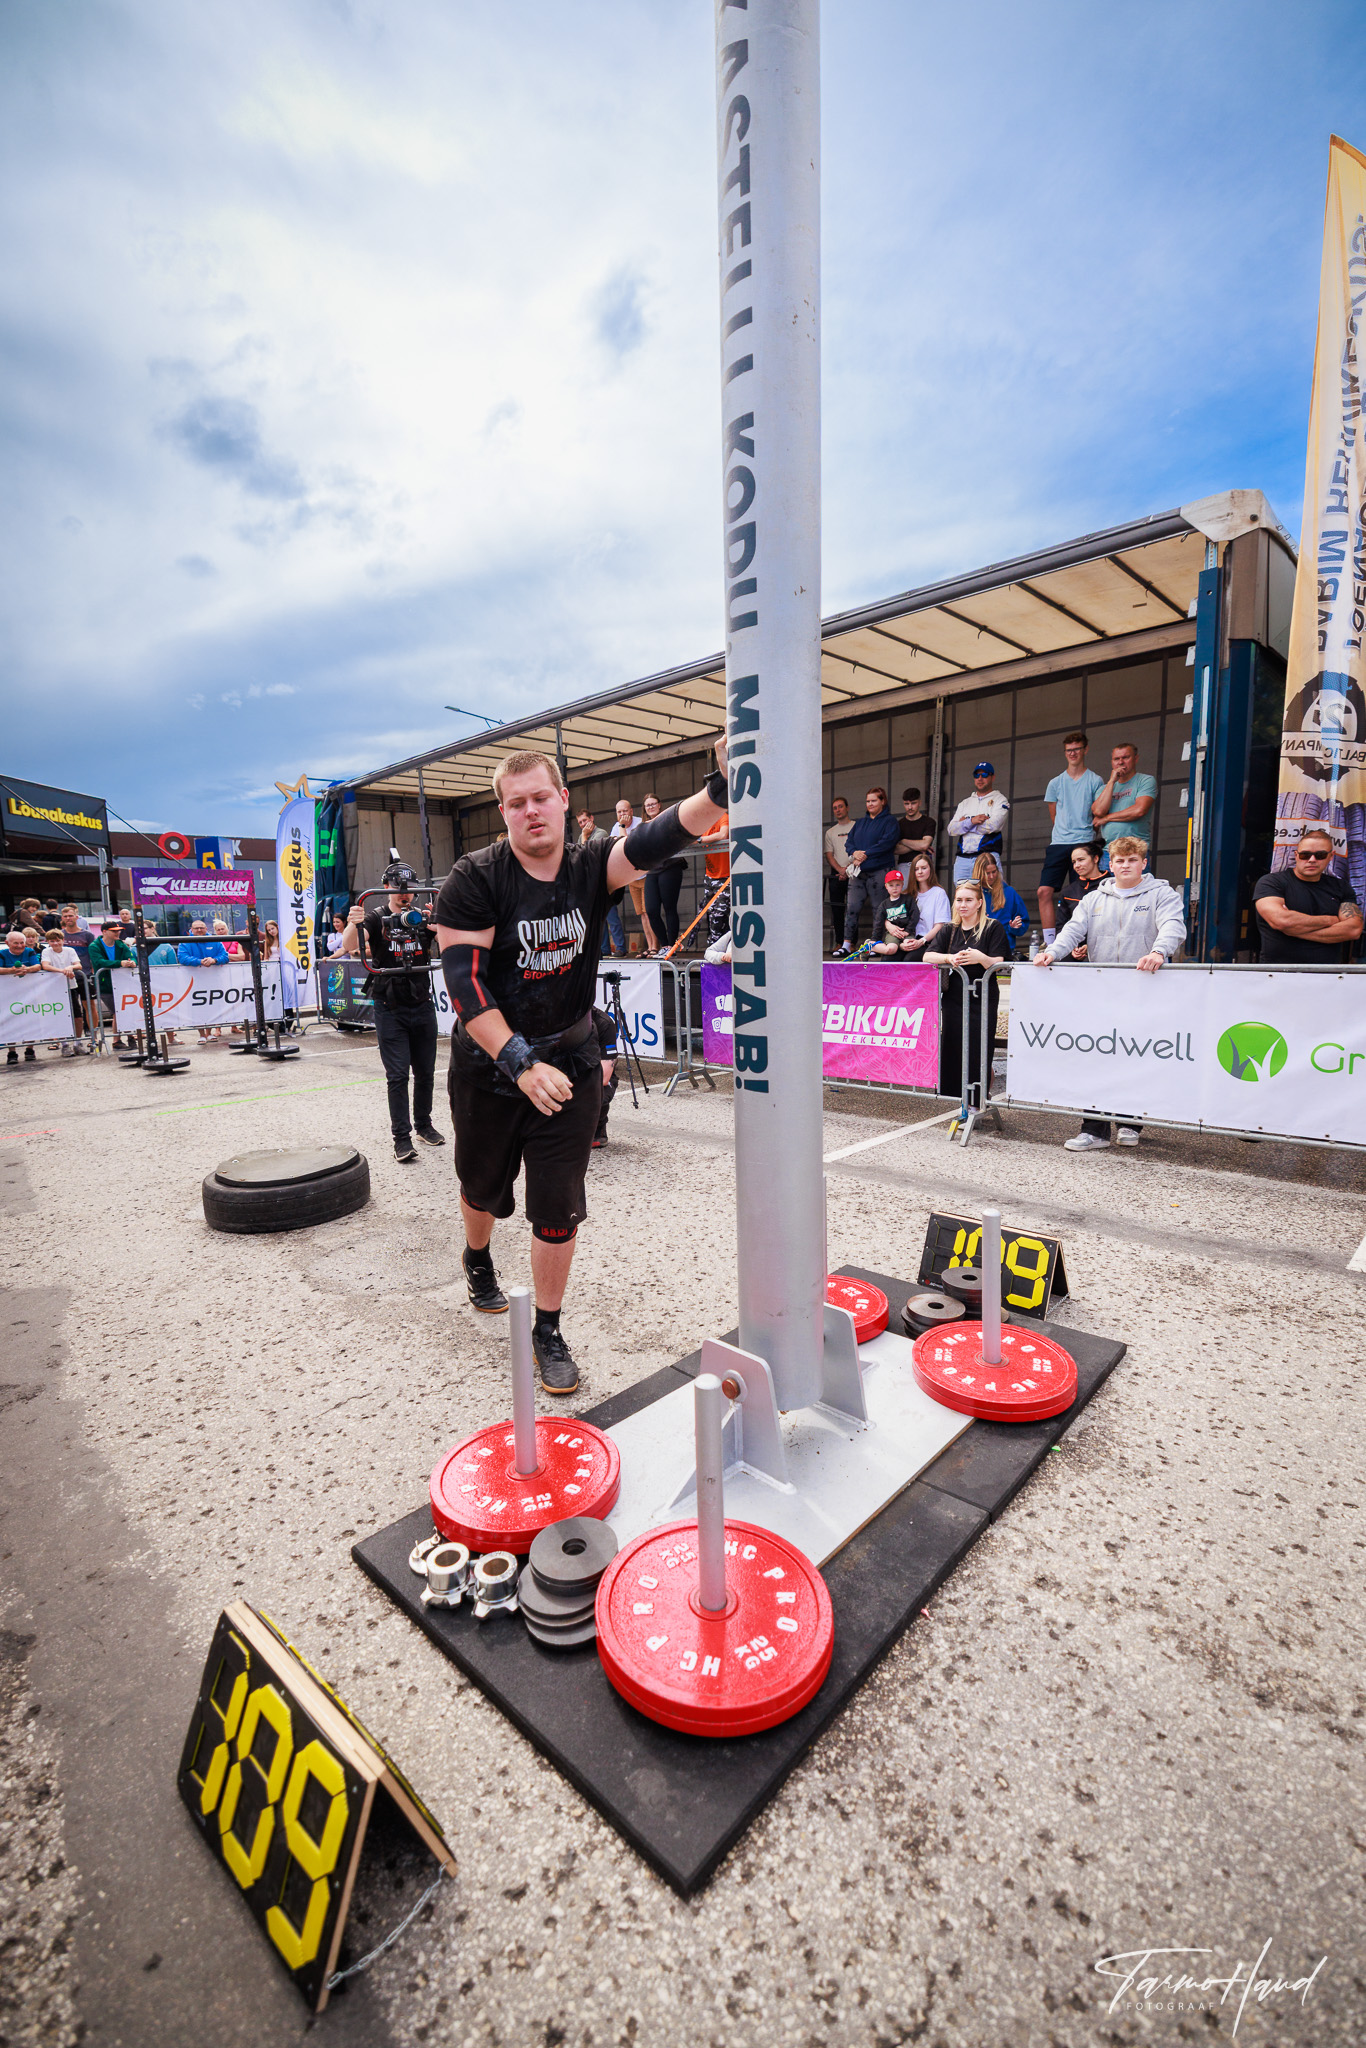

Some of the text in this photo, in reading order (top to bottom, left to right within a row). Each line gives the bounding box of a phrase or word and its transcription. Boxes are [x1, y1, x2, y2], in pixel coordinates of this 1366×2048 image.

[726, 674, 762, 804] MIS
[8, 798, 103, 831] Lõunakeskus
[170, 880, 250, 892] KLEEBIKUM
[289, 826, 308, 985] Lõunakeskus
[730, 824, 770, 1094] KESTAB!
[10, 1001, 64, 1017] Grupp
[823, 1004, 925, 1036] BIKUM
[842, 1035, 911, 1047] REKLAAM
[1020, 1021, 1195, 1062] Woodwell
[554, 1433, 583, 1448] HC
[658, 1550, 680, 1569] KG
[673, 1543, 697, 1564] 25
[724, 1540, 799, 1633] HC PRO
[633, 1574, 721, 1677] HC PRO
[734, 1644, 761, 1670] KG
[750, 1635, 778, 1662] 25
